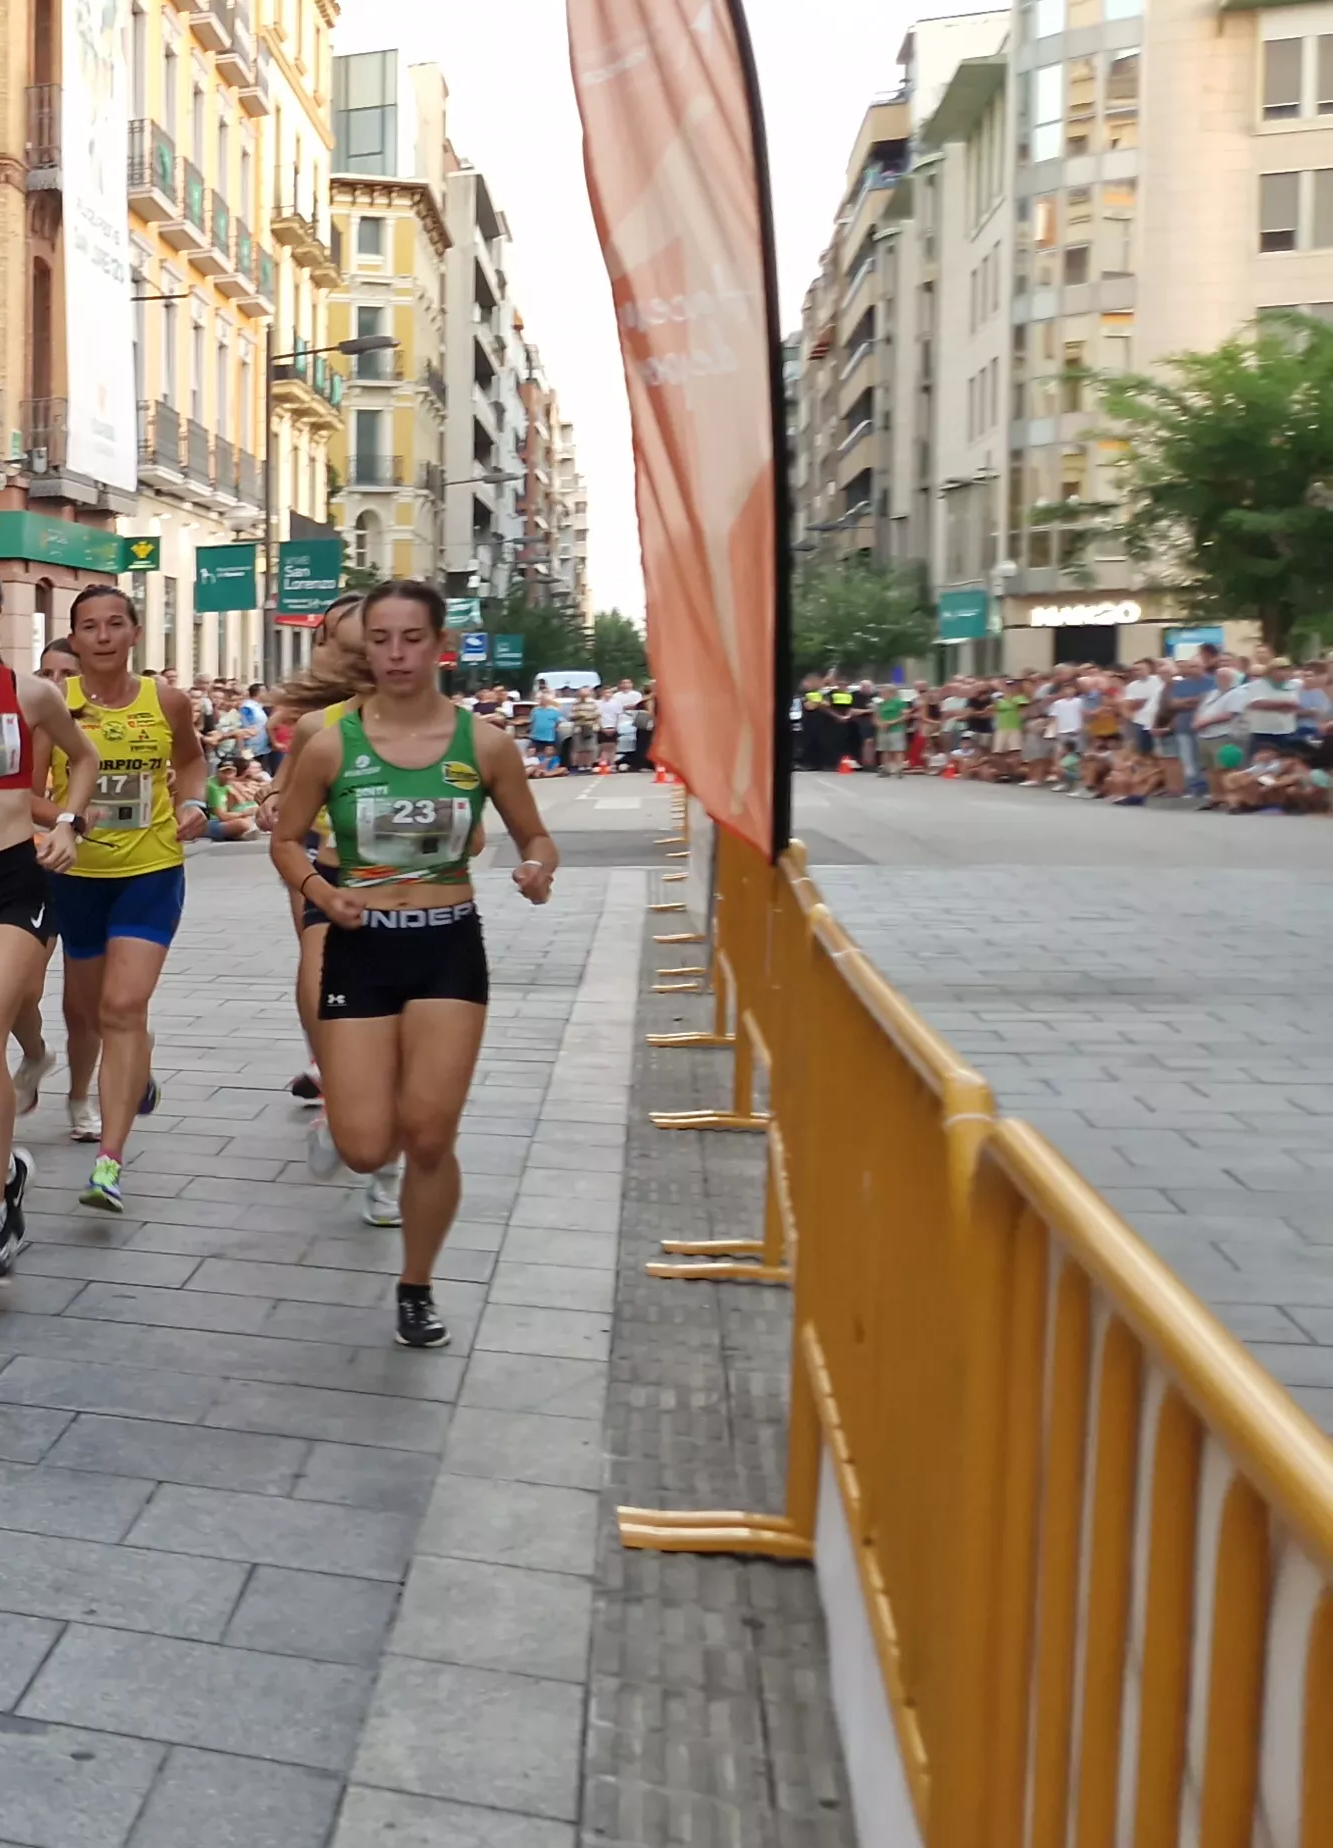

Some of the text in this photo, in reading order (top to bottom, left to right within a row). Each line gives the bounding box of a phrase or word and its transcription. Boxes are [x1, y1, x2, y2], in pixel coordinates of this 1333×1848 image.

[284, 565, 311, 577] San
[96, 775, 128, 793] 17
[392, 799, 436, 824] 23
